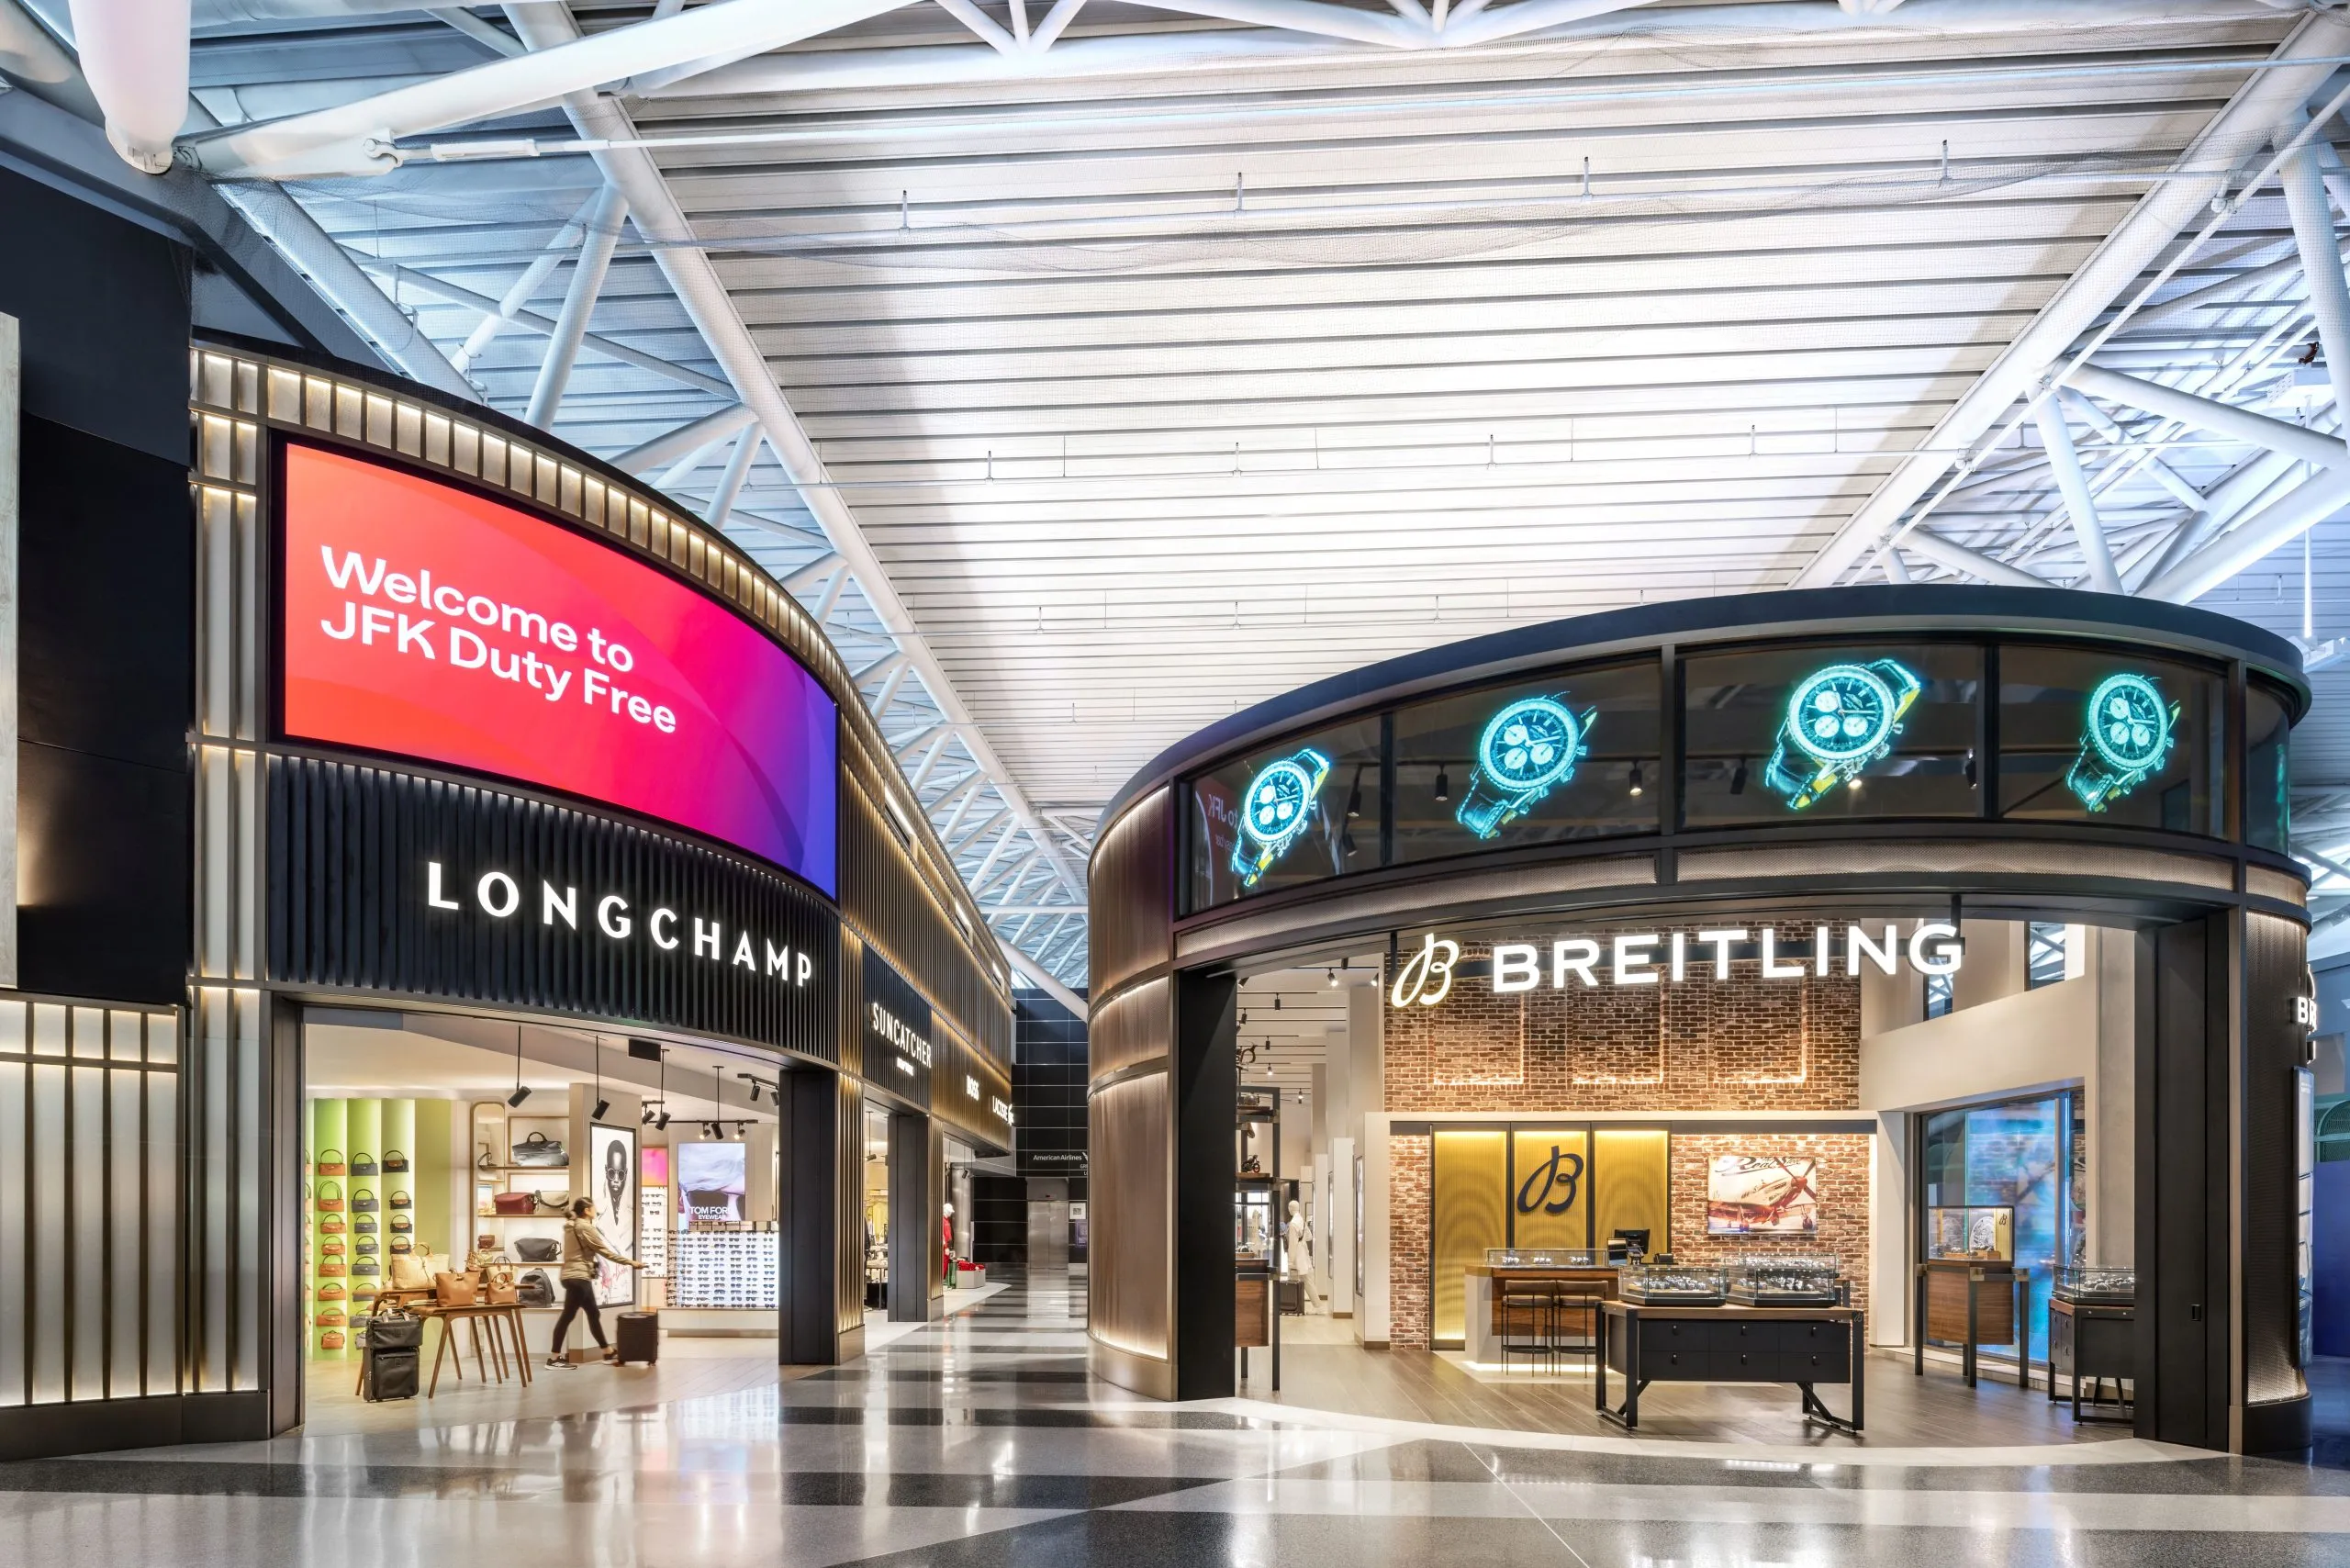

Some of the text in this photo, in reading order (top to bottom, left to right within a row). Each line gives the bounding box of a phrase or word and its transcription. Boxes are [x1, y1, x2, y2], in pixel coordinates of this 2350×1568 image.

[321, 545, 633, 672] Welcome to
[320, 601, 677, 734] JFK Duty Free
[428, 861, 812, 988] LONGCHAMP
[1493, 924, 1964, 993] BREITLING
[873, 1002, 932, 1069] SUNCATCHER
[967, 1075, 979, 1102] BOSS
[992, 1095, 1009, 1122] LACOSTE
[690, 1206, 733, 1215] TOM FOR
